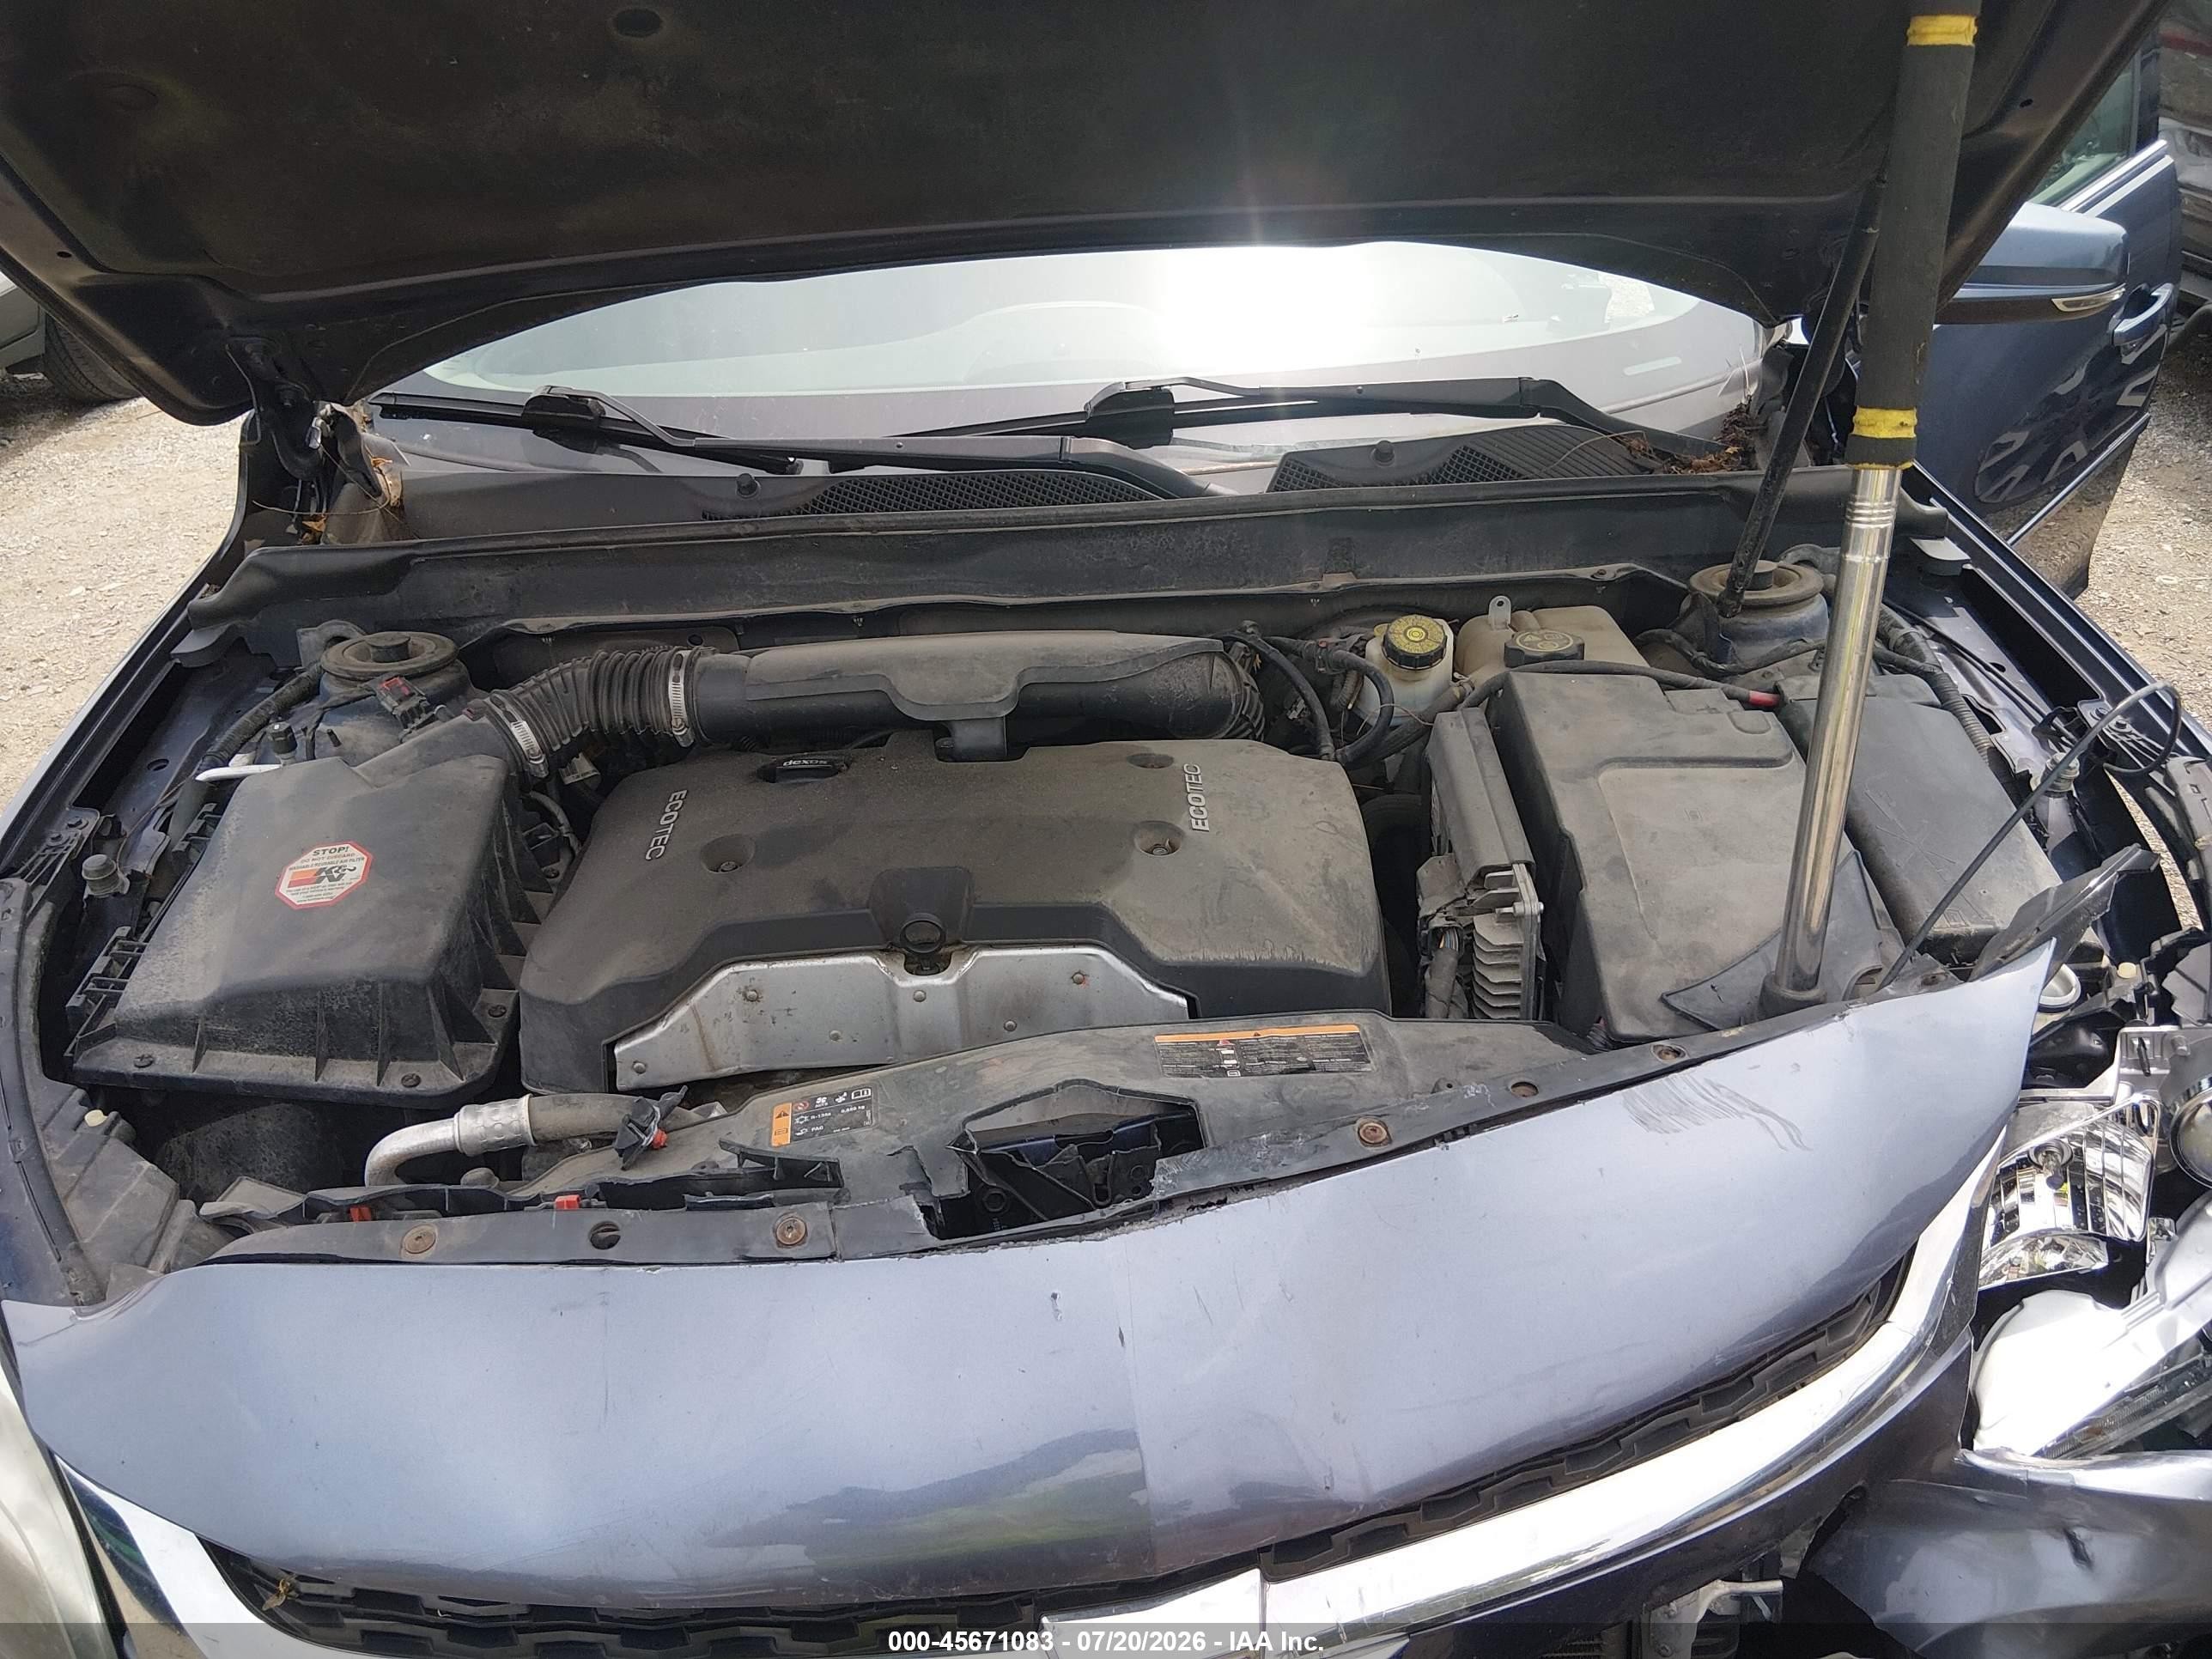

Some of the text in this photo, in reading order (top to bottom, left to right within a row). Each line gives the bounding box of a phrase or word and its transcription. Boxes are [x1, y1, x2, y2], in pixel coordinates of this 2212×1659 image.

[645, 789, 688, 860] ECOTEC
[1183, 763, 1210, 832] ECOTEC
[312, 846, 349, 856] STOP!
